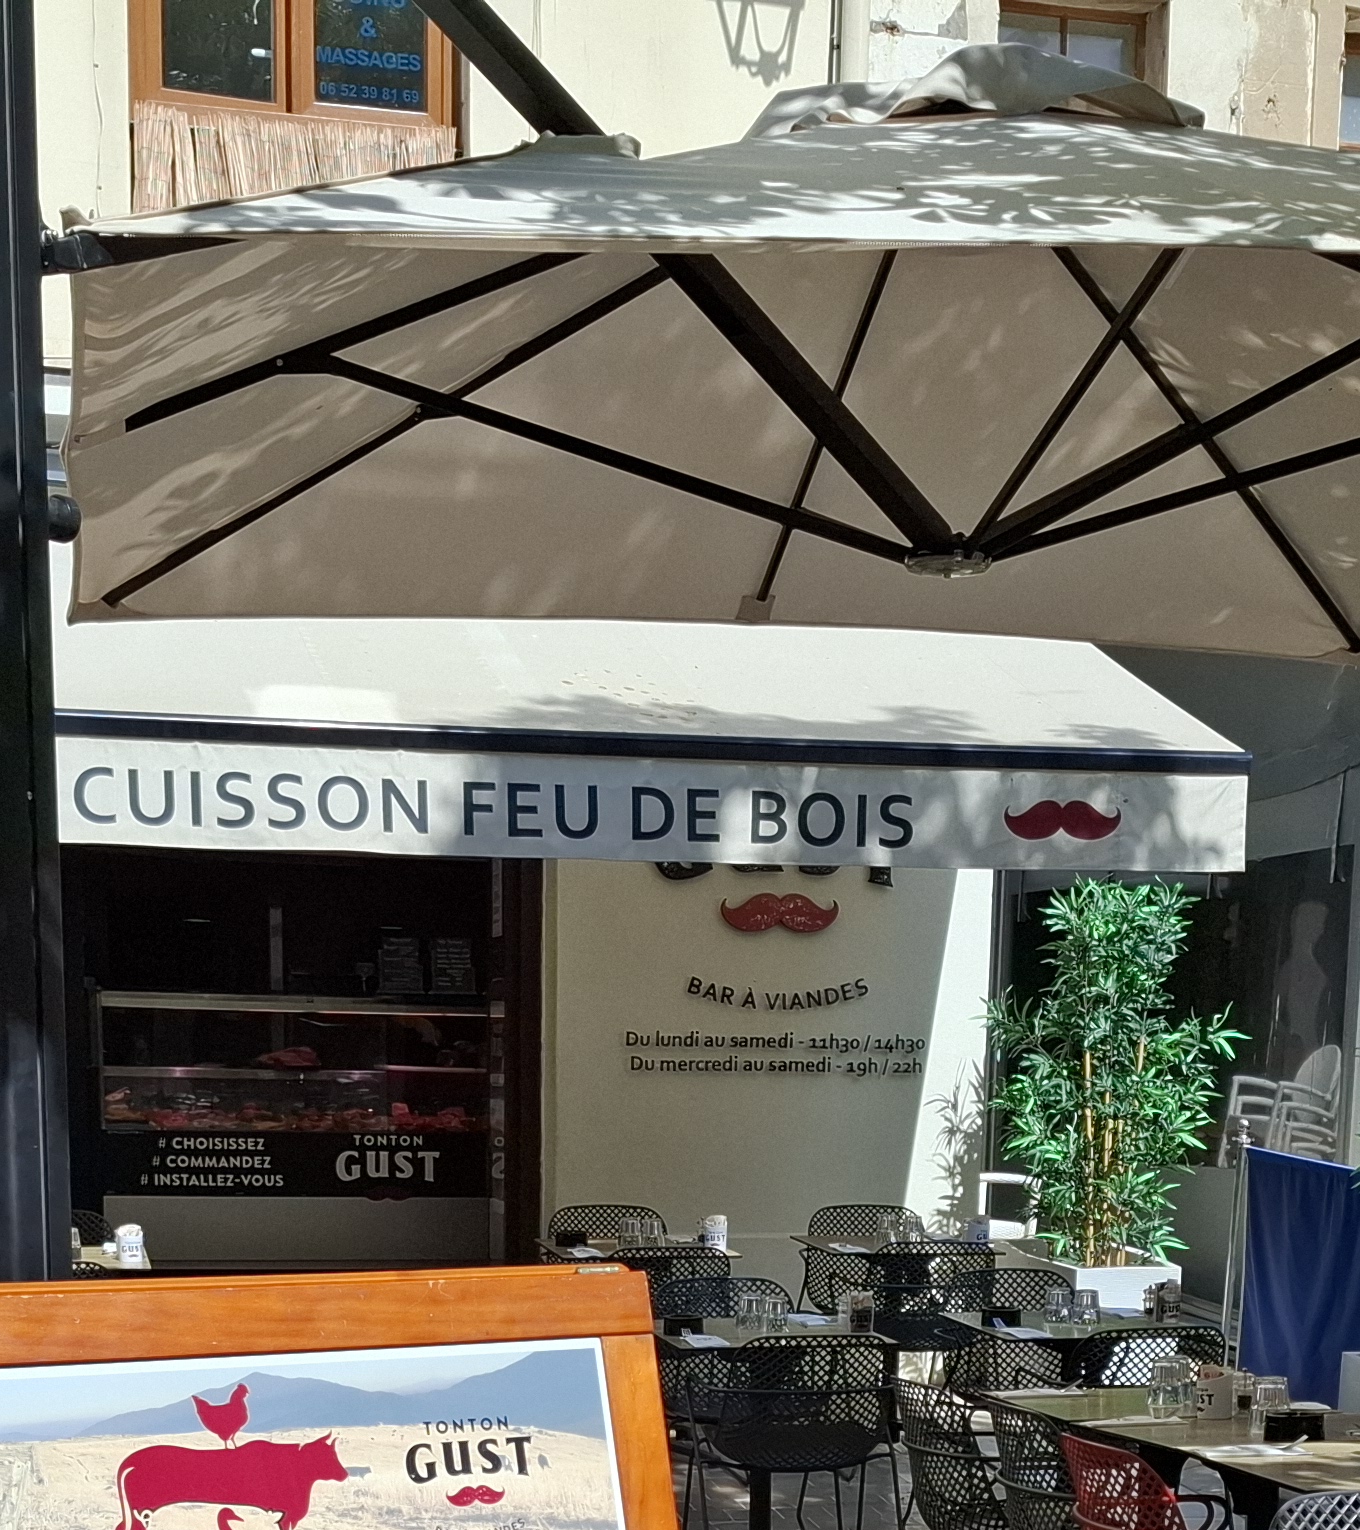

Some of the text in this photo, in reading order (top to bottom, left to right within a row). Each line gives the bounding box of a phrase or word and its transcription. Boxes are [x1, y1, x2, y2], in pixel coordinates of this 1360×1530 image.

[316, 46, 421, 71] MASSAGES
[320, 82, 419, 102] 06 52 39 81 69
[73, 765, 429, 835] CUISSON
[463, 781, 600, 840] FEU
[630, 785, 720, 844] DE
[749, 789, 914, 849] BOIS
[687, 976, 870, 1011] BAR À VIANDES
[625, 1030, 926, 1053] Du lundi au samedi 11h30 14h30
[630, 1056, 922, 1077] Du mercredi au samedi 19h 22h
[172, 1137, 265, 1150] CHOISISSEZ
[353, 1134, 424, 1147] TONTON
[166, 1155, 272, 1169] COMMANDEZ
[335, 1150, 440, 1182] GUST
[154, 1173, 284, 1187] INSTALLEZ-VOUS
[422, 1416, 508, 1435] TONTON
[405, 1436, 531, 1484] GUST
